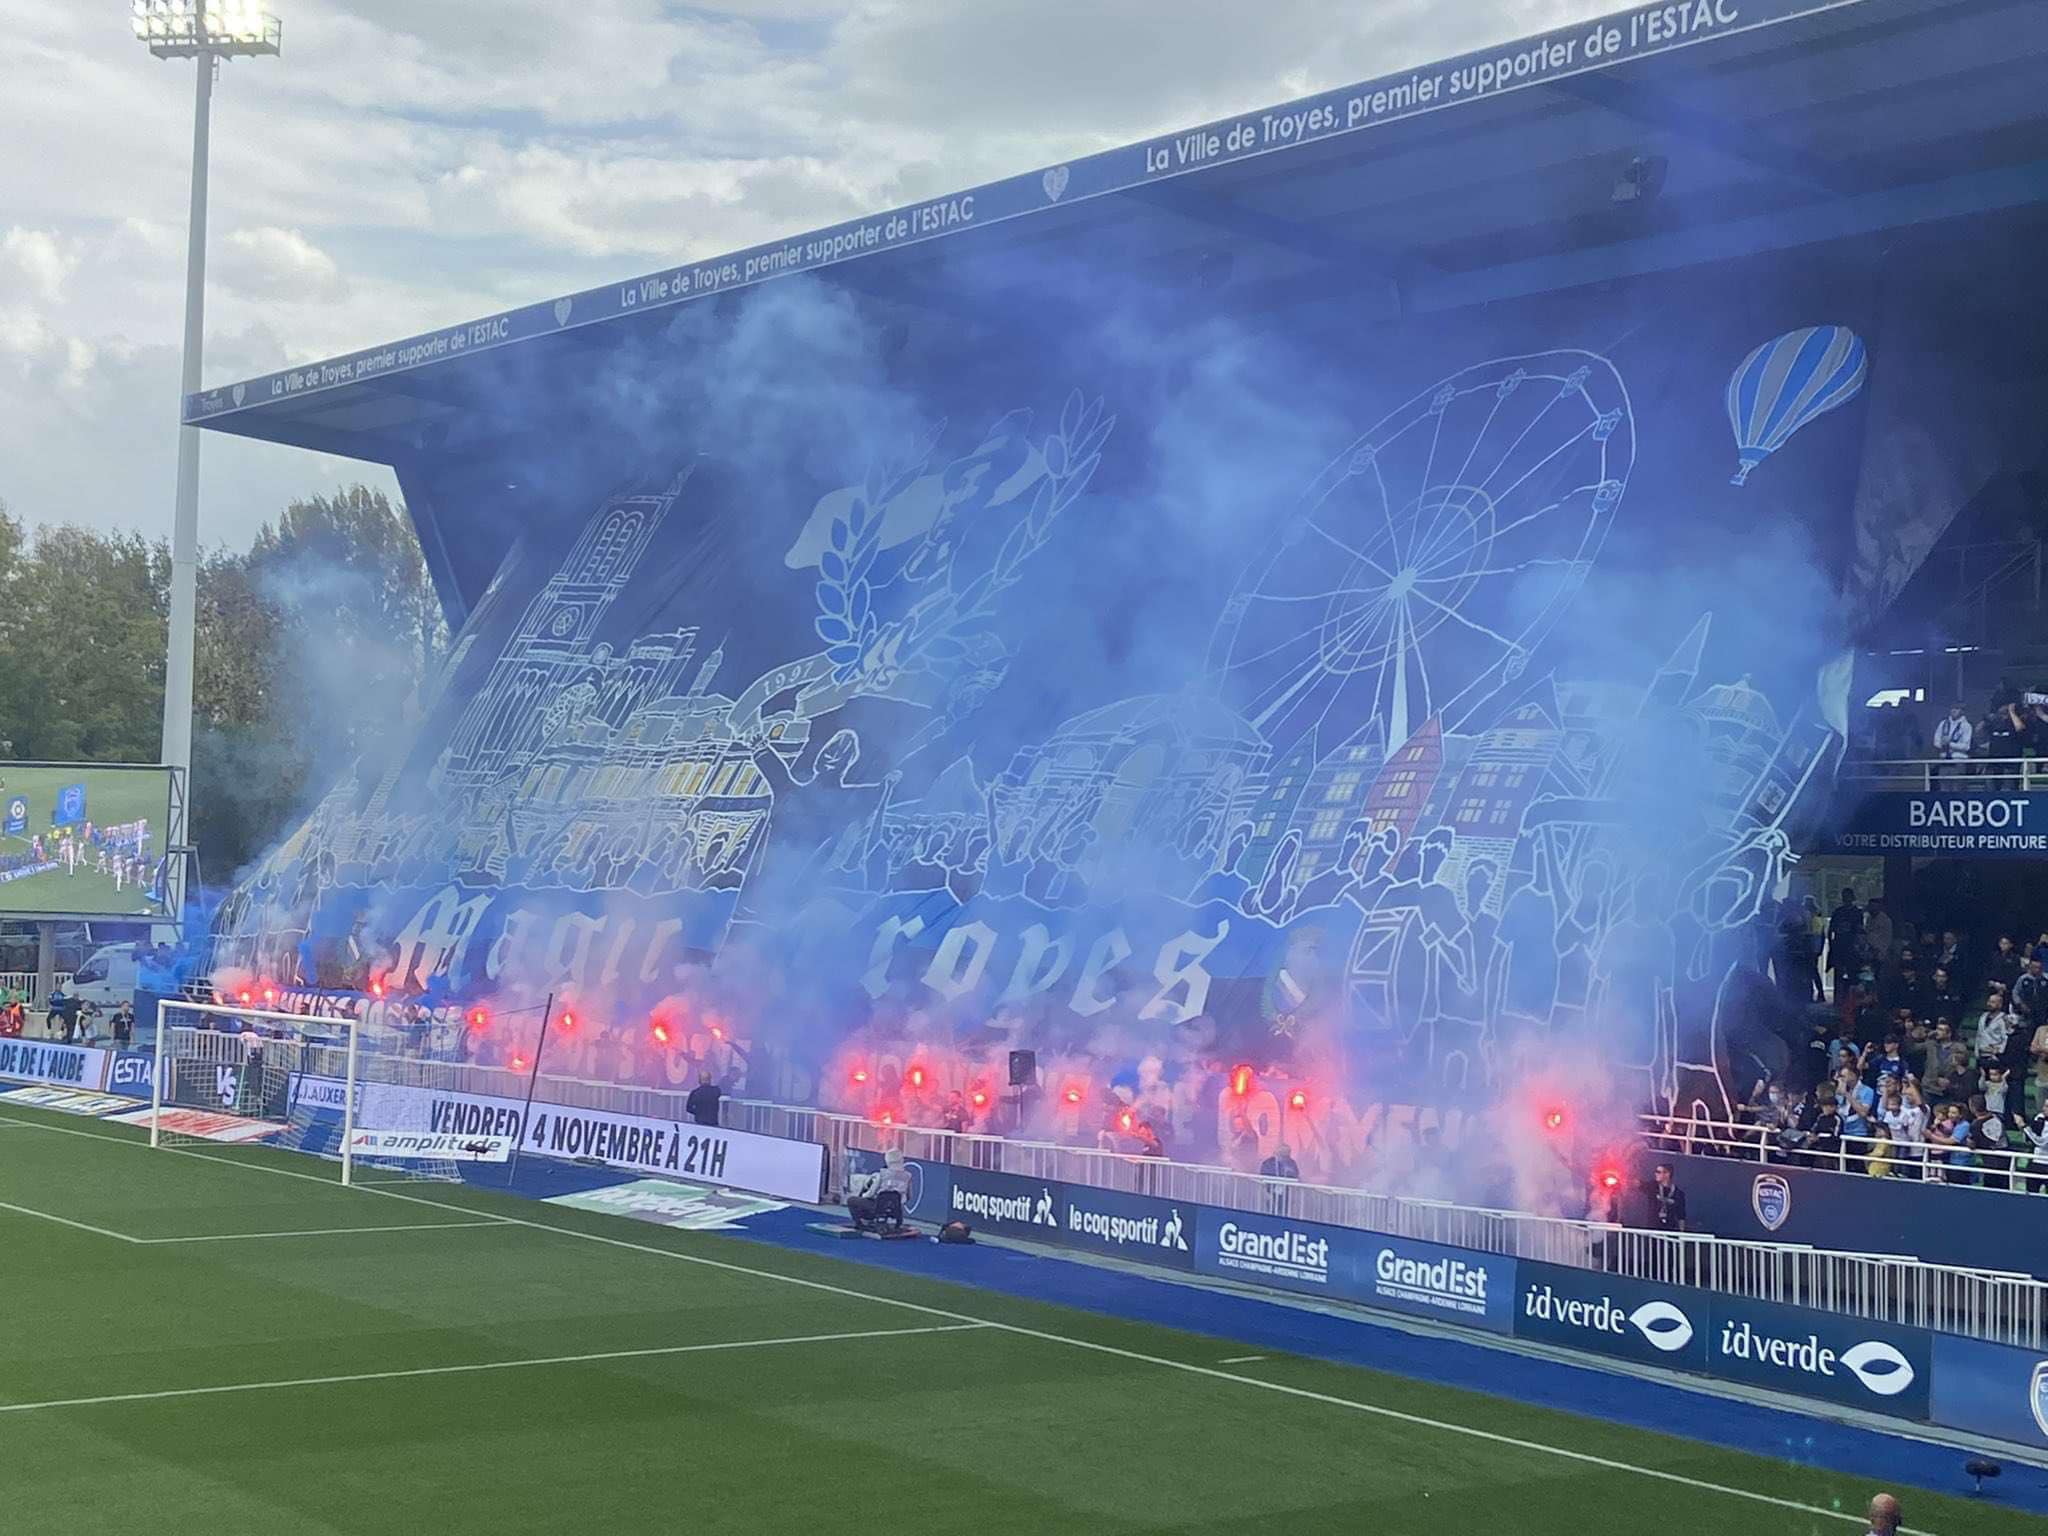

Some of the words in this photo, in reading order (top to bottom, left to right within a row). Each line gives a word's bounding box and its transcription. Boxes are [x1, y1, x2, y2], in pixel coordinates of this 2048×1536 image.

[1145, 147, 1170, 173] La
[1175, 131, 1221, 164] Ville
[1226, 123, 1257, 152] de
[1261, 103, 1341, 142] Troyes,
[1347, 74, 1443, 128] premier
[1449, 39, 1578, 94] supporter
[1583, 25, 1622, 59] de
[620, 287, 636, 308] La
[638, 280, 668, 302] Ville
[671, 274, 690, 294] de
[693, 262, 742, 290] Troyes,
[745, 246, 803, 282] premier
[805, 224, 884, 262] supporter
[886, 214, 909, 240] de
[912, 196, 976, 234] l'ESTAC
[271, 379, 282, 395] La
[284, 374, 305, 395] Ville
[305, 371, 320, 387] de
[355, 350, 397, 377] premier
[397, 337, 448, 367] supporter
[450, 333, 467, 350] de
[468, 317, 510, 346] l'ESTAC
[1909, 799, 2030, 828] BARBOT
[1835, 833, 1878, 848] VOTRE
[1880, 834, 1974, 850] DISTRIBUTEUR
[1978, 834, 2047, 850] PEINTURE
[383, 1135, 502, 1152] amplitude
[532, 1113, 547, 1148] 4
[550, 1115, 665, 1167] NOVEMBRE
[665, 1123, 680, 1171] À
[683, 1134, 728, 1179] 21H
[953, 1184, 964, 1210] le
[965, 1192, 989, 1219] coq
[989, 1197, 1031, 1223] sportif
[1070, 1204, 1082, 1231] le
[1083, 1214, 1110, 1241] coq
[1111, 1217, 1158, 1245] sportif
